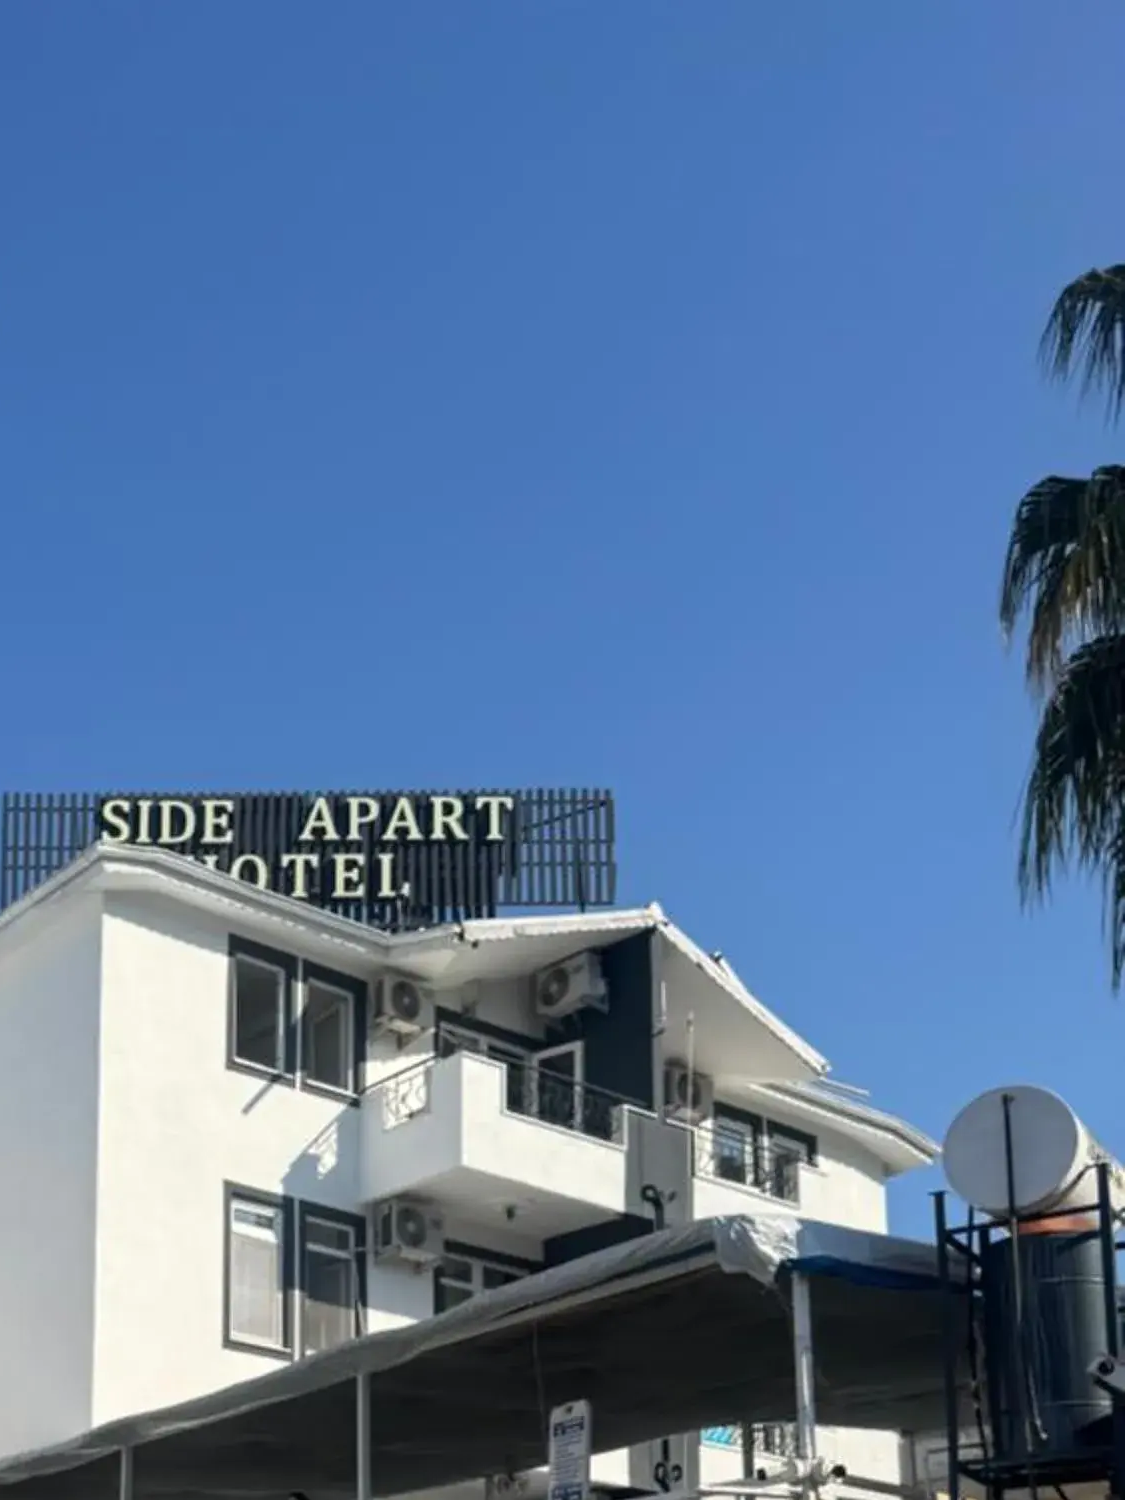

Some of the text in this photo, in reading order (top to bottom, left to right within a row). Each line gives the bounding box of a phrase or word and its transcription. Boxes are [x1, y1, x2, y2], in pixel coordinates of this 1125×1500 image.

[101, 796, 514, 843] SIDE APART
[184, 853, 410, 898] OTEL
